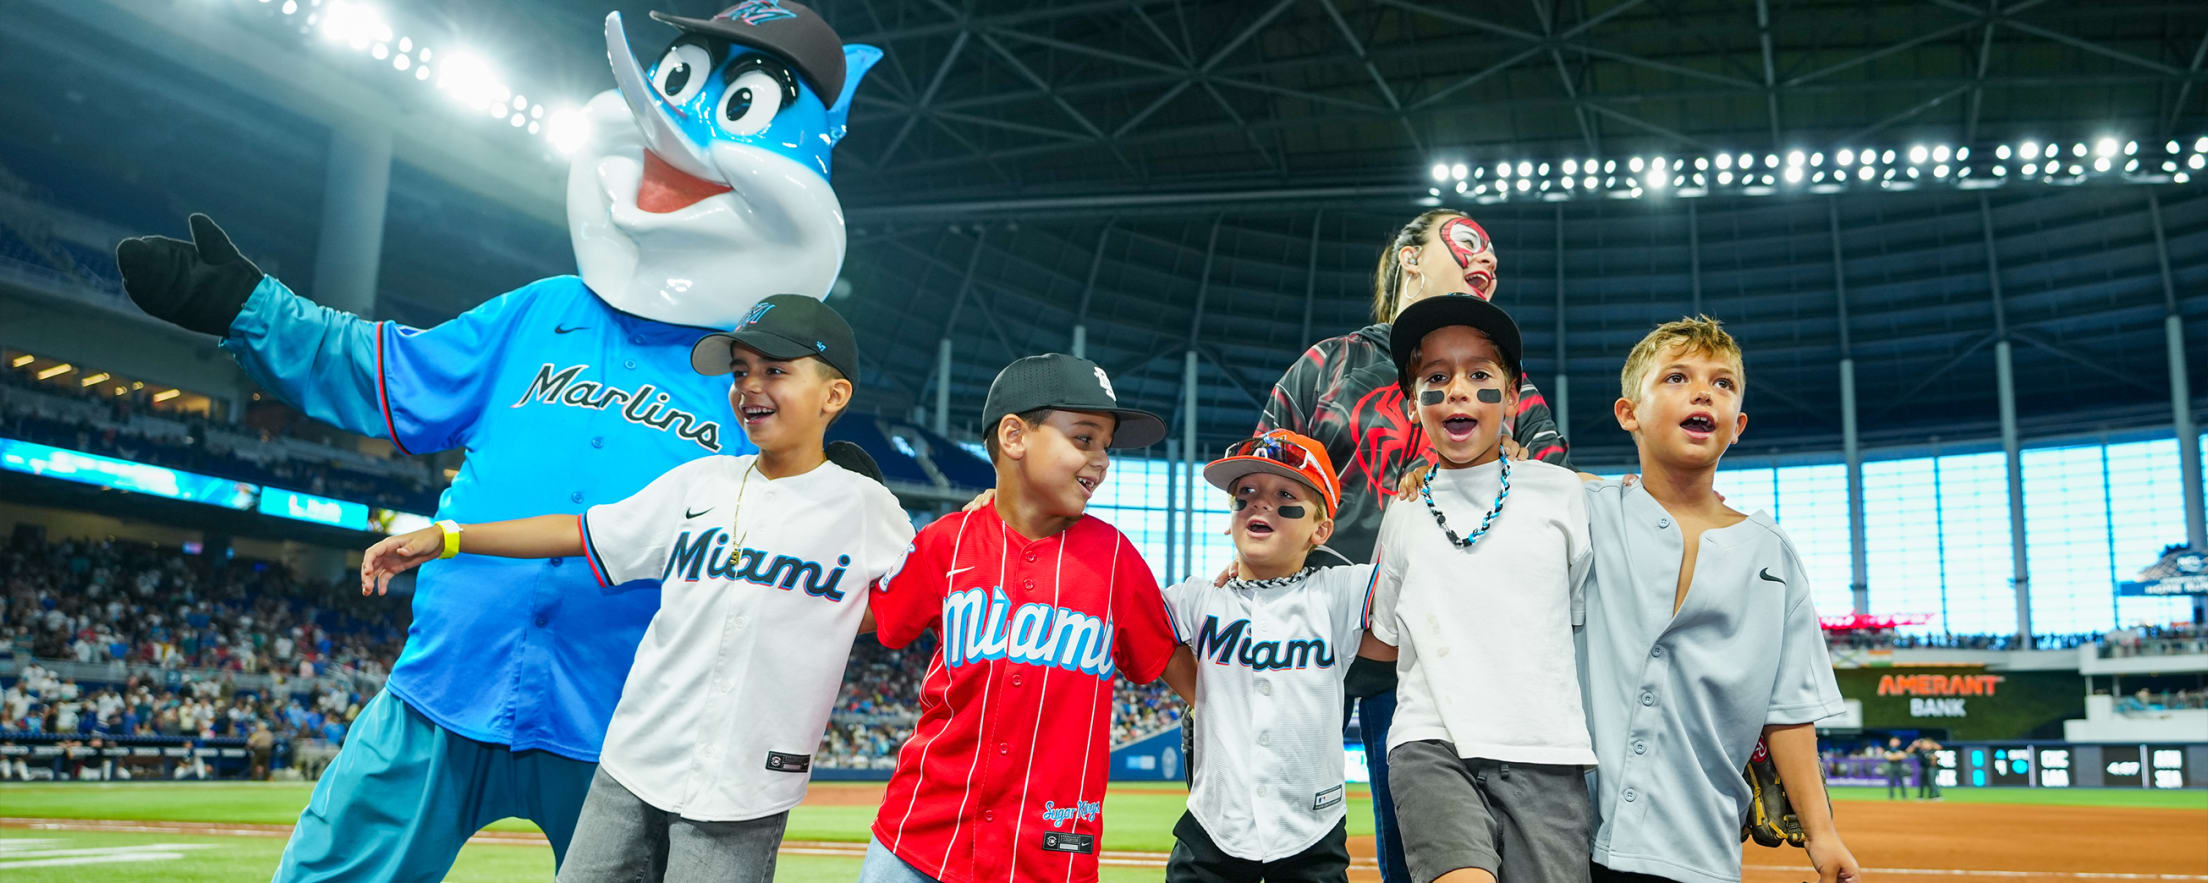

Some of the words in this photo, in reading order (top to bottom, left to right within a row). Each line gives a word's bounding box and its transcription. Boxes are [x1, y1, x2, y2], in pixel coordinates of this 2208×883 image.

[510, 363, 723, 453] Marlins
[662, 526, 851, 603] Miami
[1197, 614, 1336, 672] Miam
[1877, 674, 2005, 696] AMERANT
[1910, 698, 1967, 717] BANK
[1043, 800, 1077, 828] Sugar
